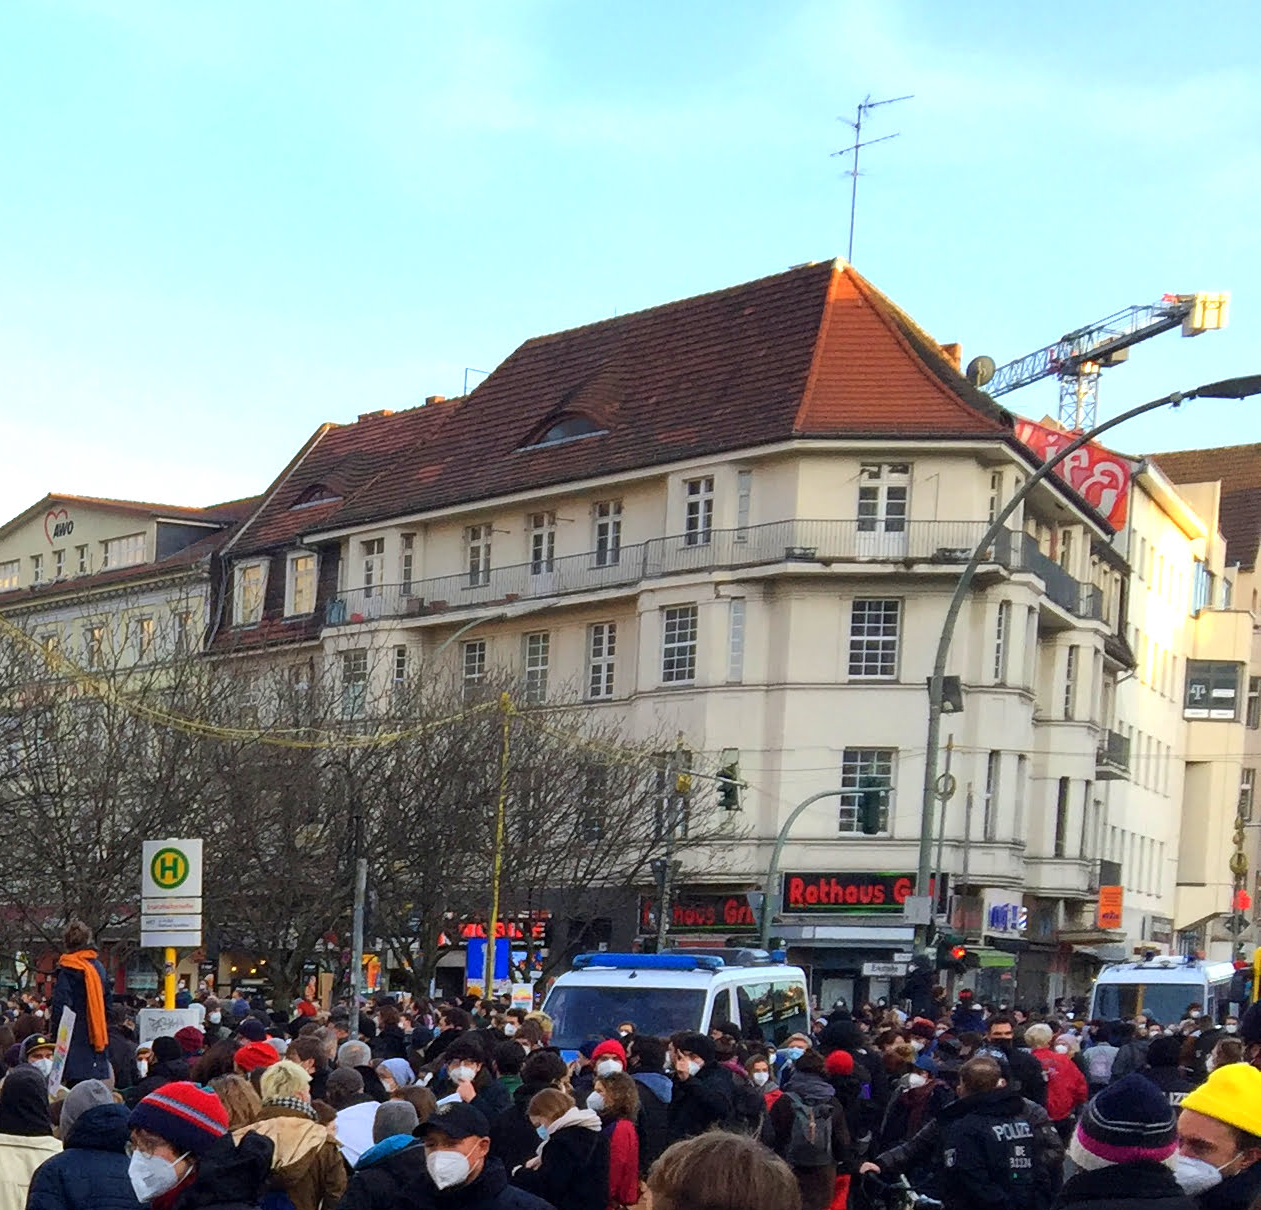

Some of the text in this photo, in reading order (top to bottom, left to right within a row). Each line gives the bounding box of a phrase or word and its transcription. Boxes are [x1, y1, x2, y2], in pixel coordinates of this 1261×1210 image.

[53, 520, 74, 538] AWO
[160, 857, 179, 879] H
[790, 877, 885, 904] Rathaus
[992, 1122, 1034, 1141] POLIZE
